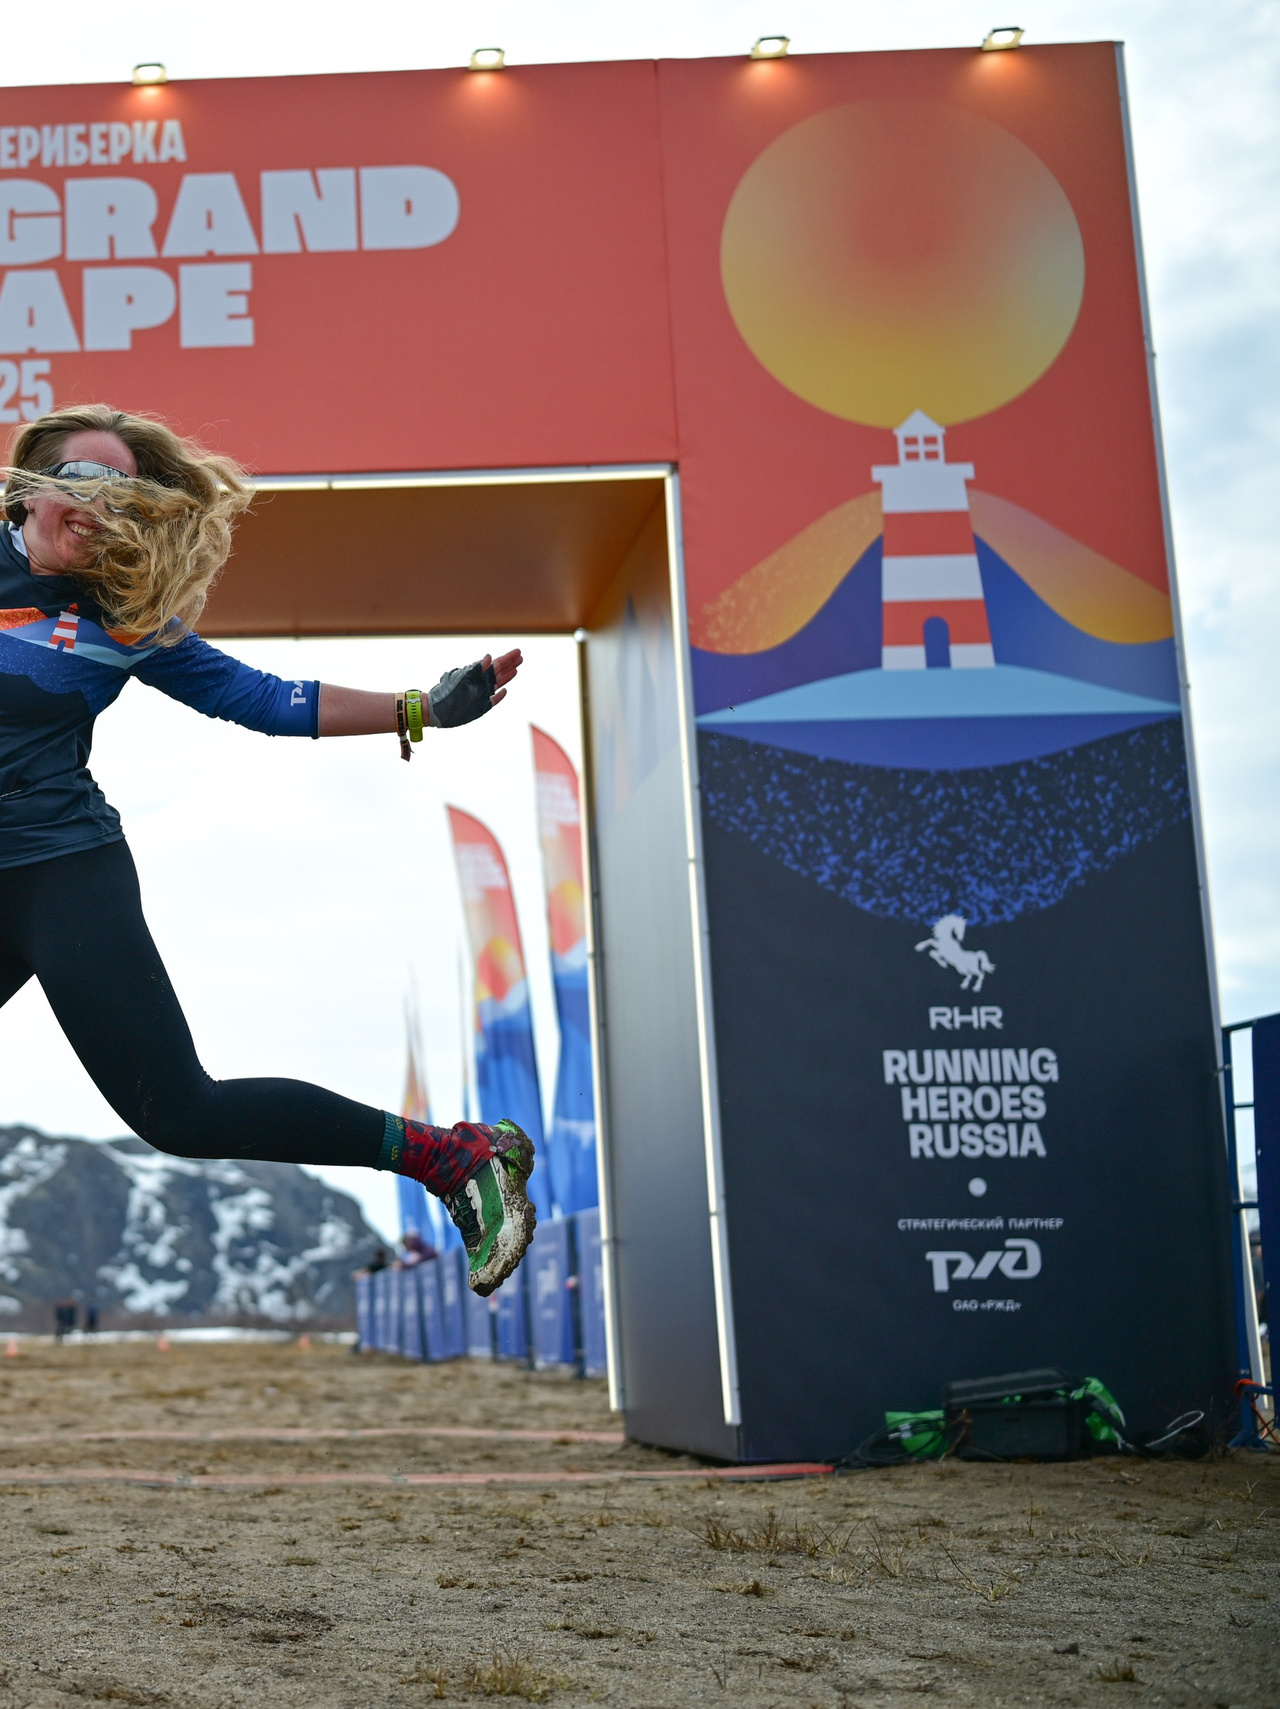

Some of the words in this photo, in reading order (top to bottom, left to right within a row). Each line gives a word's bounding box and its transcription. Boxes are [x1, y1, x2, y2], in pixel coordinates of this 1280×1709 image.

[928, 1006, 1004, 1030] RHR
[882, 1048, 1059, 1085] RUNNING
[900, 1085, 1046, 1121] HEROES
[909, 1122, 1046, 1159] RUSSIA
[897, 1216, 1004, 1231] СТРАТЕГИЧЕСКИЙ
[1008, 1218, 1064, 1230] ПАРТНЕР
